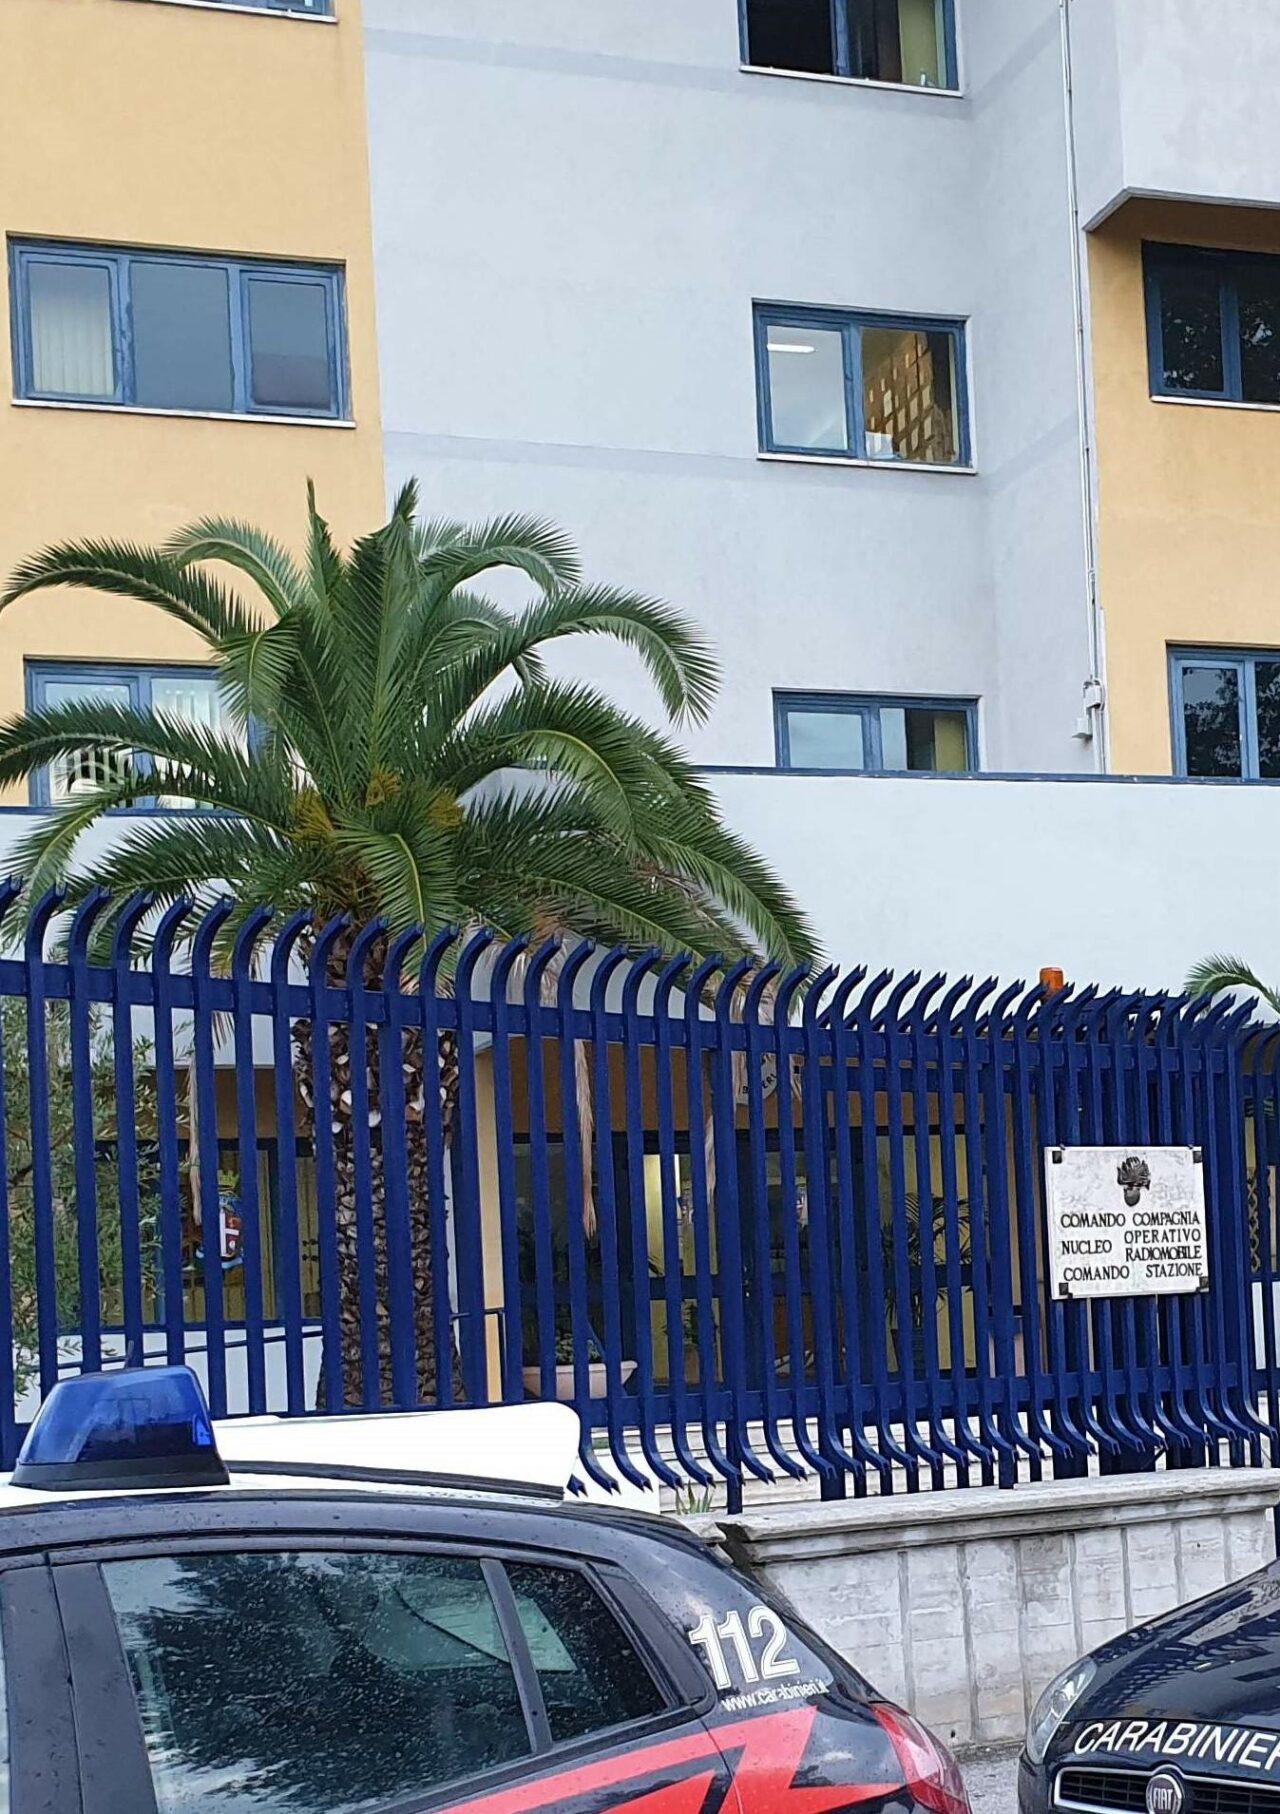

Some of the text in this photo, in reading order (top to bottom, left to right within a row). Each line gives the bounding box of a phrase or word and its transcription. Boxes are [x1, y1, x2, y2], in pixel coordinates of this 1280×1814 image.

[1060, 1211, 1200, 1228] COMANDO COMPAGNIA
[1124, 1228, 1201, 1244] OPERATIVO
[1061, 1239, 1112, 1255] NUCLEO
[1125, 1245, 1202, 1262] RADIOMOBILE
[1063, 1262, 1203, 1281] COMANDO STAZIONE
[688, 1605, 800, 1690] 112
[721, 1678, 829, 1712] www.carabinieri.it
[1153, 1787, 1173, 1810] FIAT
